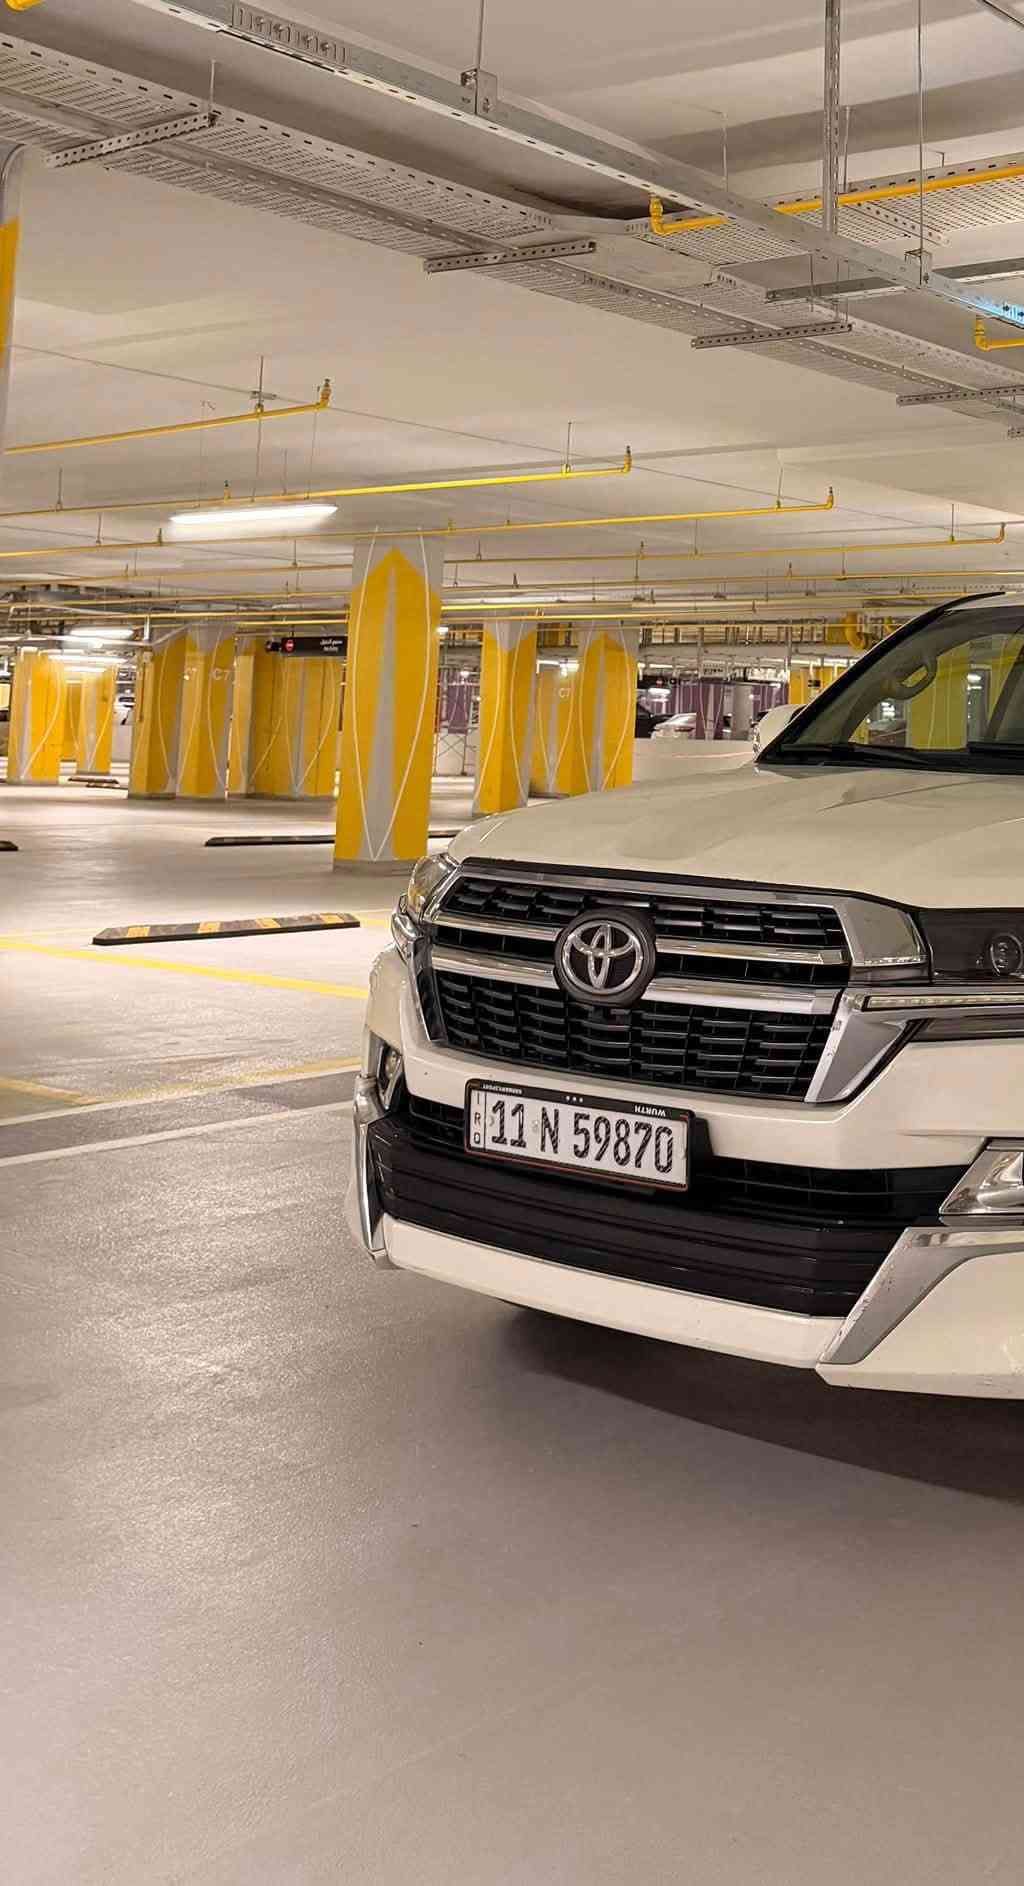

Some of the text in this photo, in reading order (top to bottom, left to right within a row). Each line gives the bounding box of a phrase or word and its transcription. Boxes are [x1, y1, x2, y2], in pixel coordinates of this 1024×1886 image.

[491, 1101, 674, 1174] 11 N 59870
